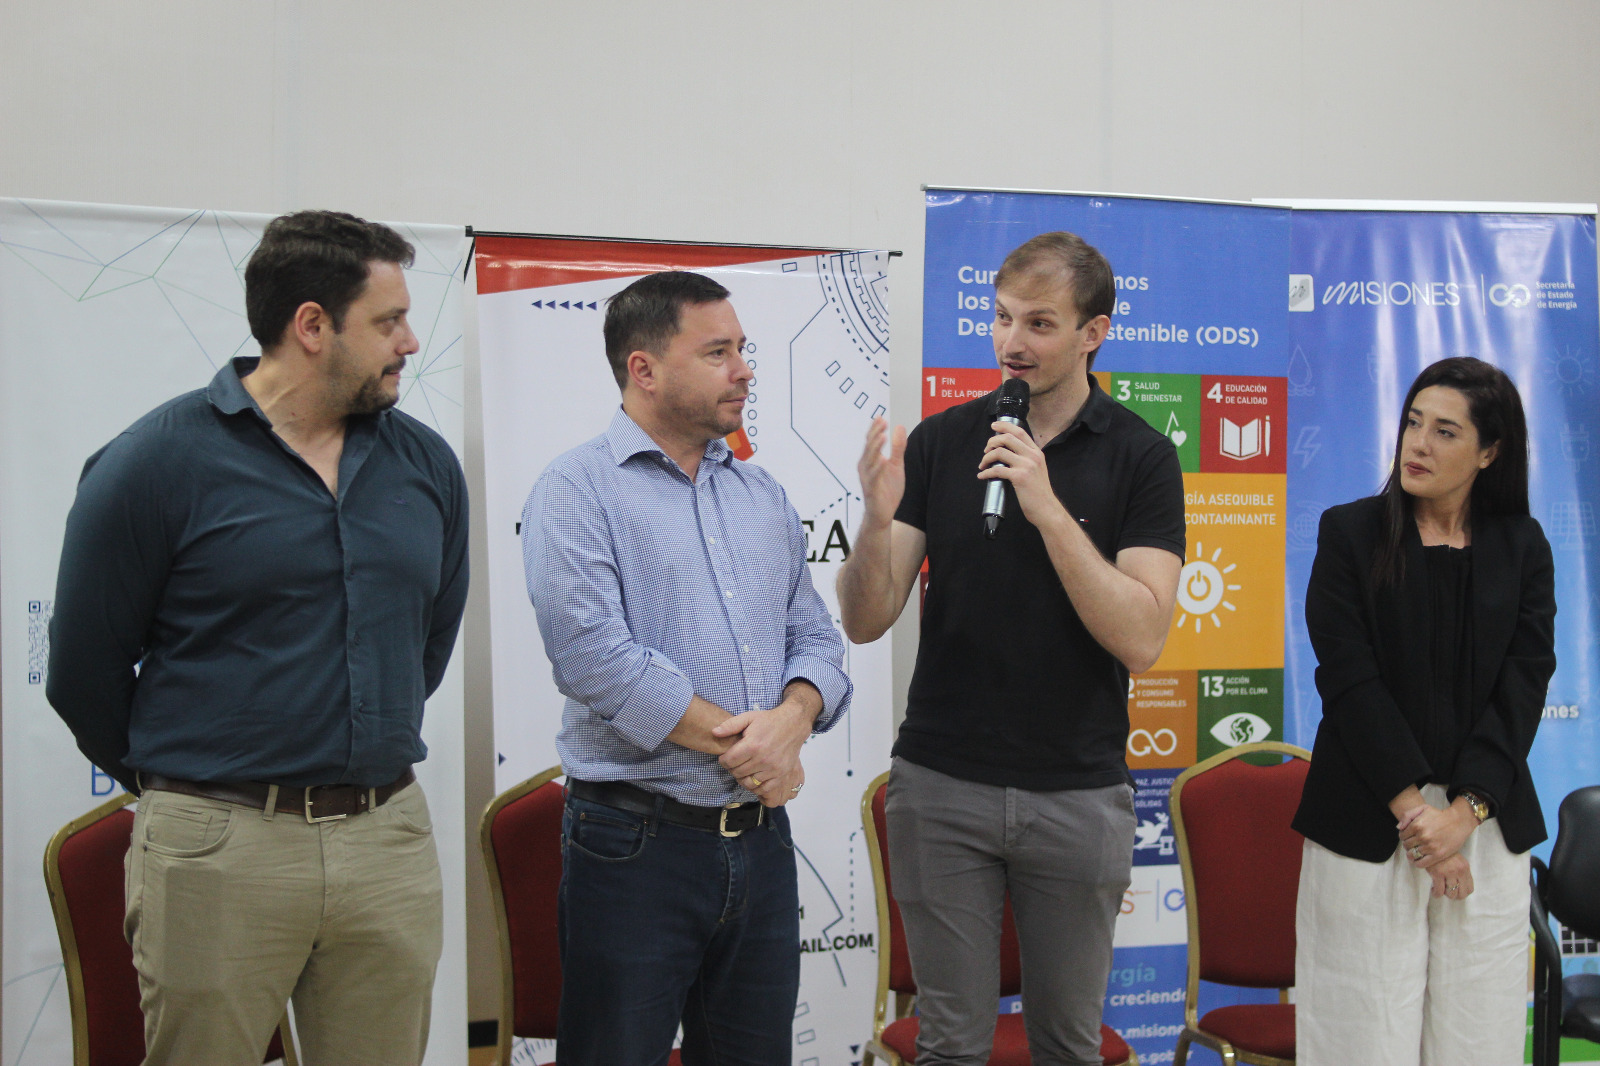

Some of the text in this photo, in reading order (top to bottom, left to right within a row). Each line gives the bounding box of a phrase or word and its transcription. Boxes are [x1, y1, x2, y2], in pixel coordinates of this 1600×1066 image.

[1322, 281, 1461, 306] MISIONES
[1548, 291, 1574, 299] Estado
[957, 291, 991, 311] los
[1195, 326, 1259, 348] (ODS)
[926, 375, 937, 397] 1
[941, 377, 956, 386] FIN
[1117, 379, 1131, 401] 3
[1134, 382, 1160, 391] SALUD
[1225, 383, 1267, 393] EDUCACIÓN
[941, 389, 953, 398] DE
[954, 389, 965, 398] LA
[1207, 382, 1223, 403] 4
[1134, 394, 1183, 403] Y BIENESTAR
[1225, 396, 1268, 405] DE CALIDAD
[1183, 491, 1275, 506] GÍA ASEQUIBLE
[1184, 513, 1277, 526] CONTAMINANTE
[1136, 678, 1179, 687] PRODUCCIÓN
[1226, 675, 1250, 684] ACCIÓN
[1201, 676, 1224, 697] 13
[1226, 686, 1268, 695] POR EL CLIMA
[1136, 690, 1142, 698] Y
